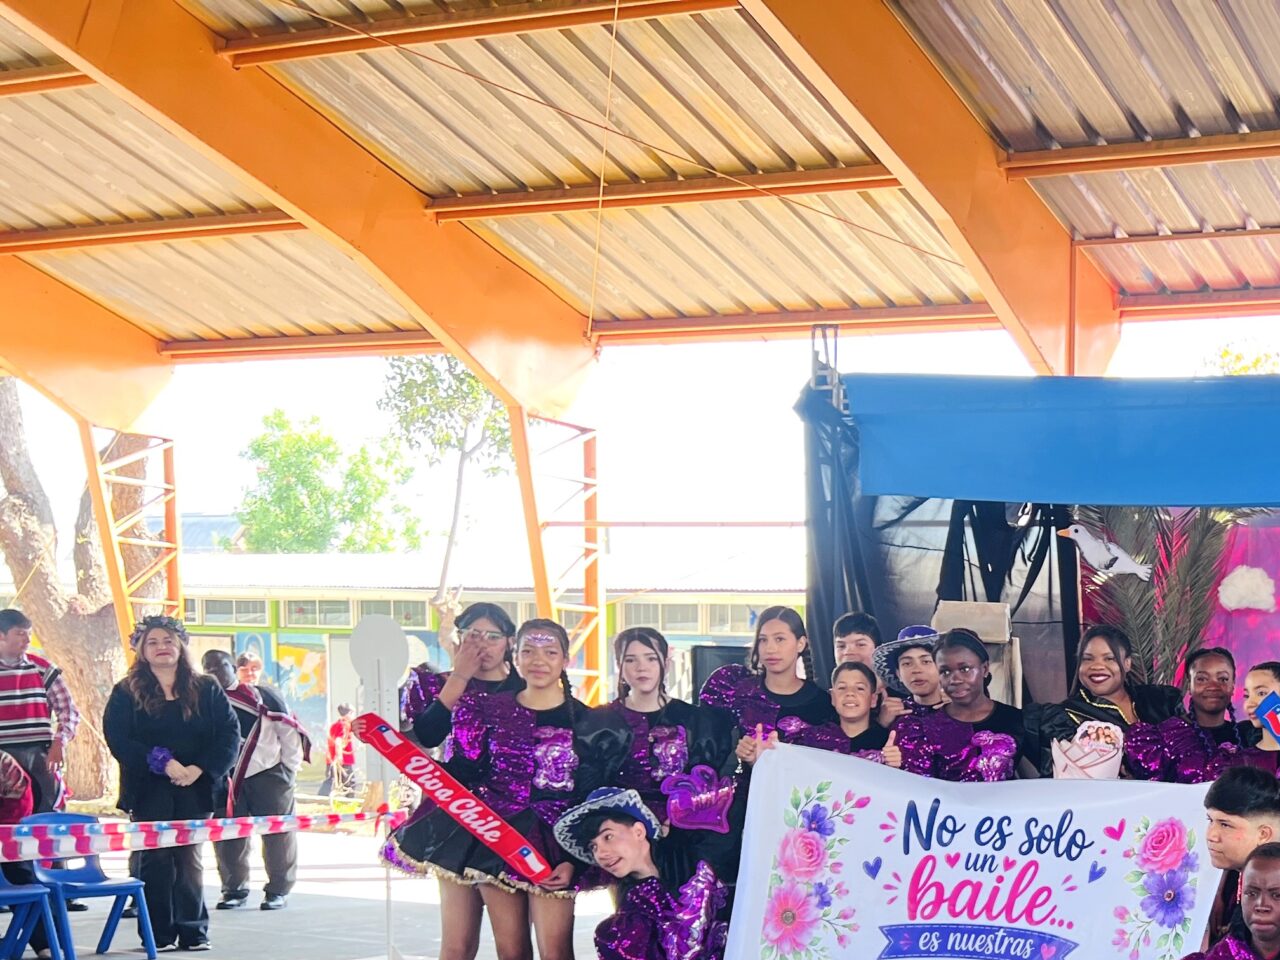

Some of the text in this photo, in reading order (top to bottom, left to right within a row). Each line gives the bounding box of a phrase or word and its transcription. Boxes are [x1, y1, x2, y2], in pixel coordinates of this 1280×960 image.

[404, 756, 502, 842] Viva Chile
[903, 798, 1095, 861] No es solo
[907, 854, 1074, 929] baile...
[964, 852, 998, 873] un
[918, 928, 1034, 959] es nuestras
